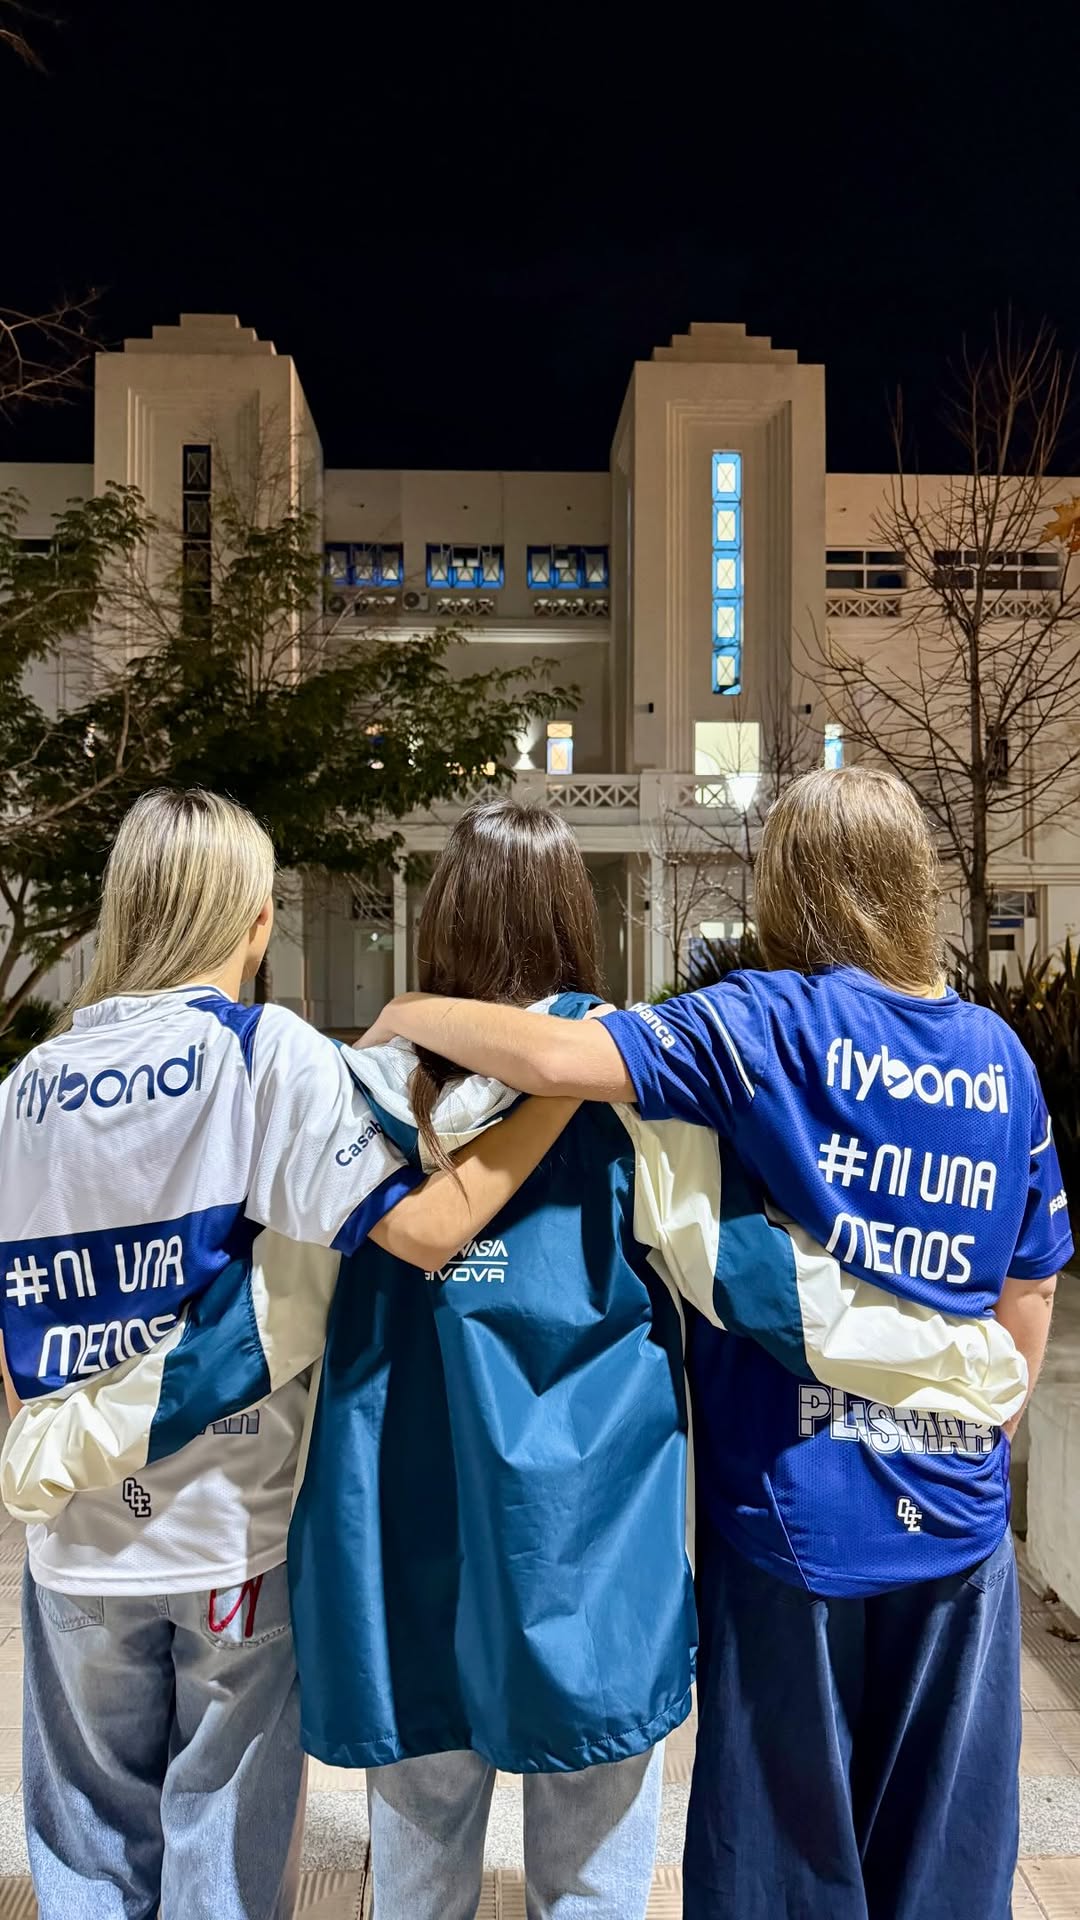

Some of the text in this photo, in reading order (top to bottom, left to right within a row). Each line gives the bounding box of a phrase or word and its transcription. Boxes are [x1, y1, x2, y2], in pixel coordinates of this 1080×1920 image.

[16, 1042, 207, 1124] flybondi
[826, 1037, 1009, 1114] flybondi
[921, 1151, 997, 1211] UNA
[115, 1234, 184, 1293] UNA
[825, 1212, 976, 1284] MENOS
